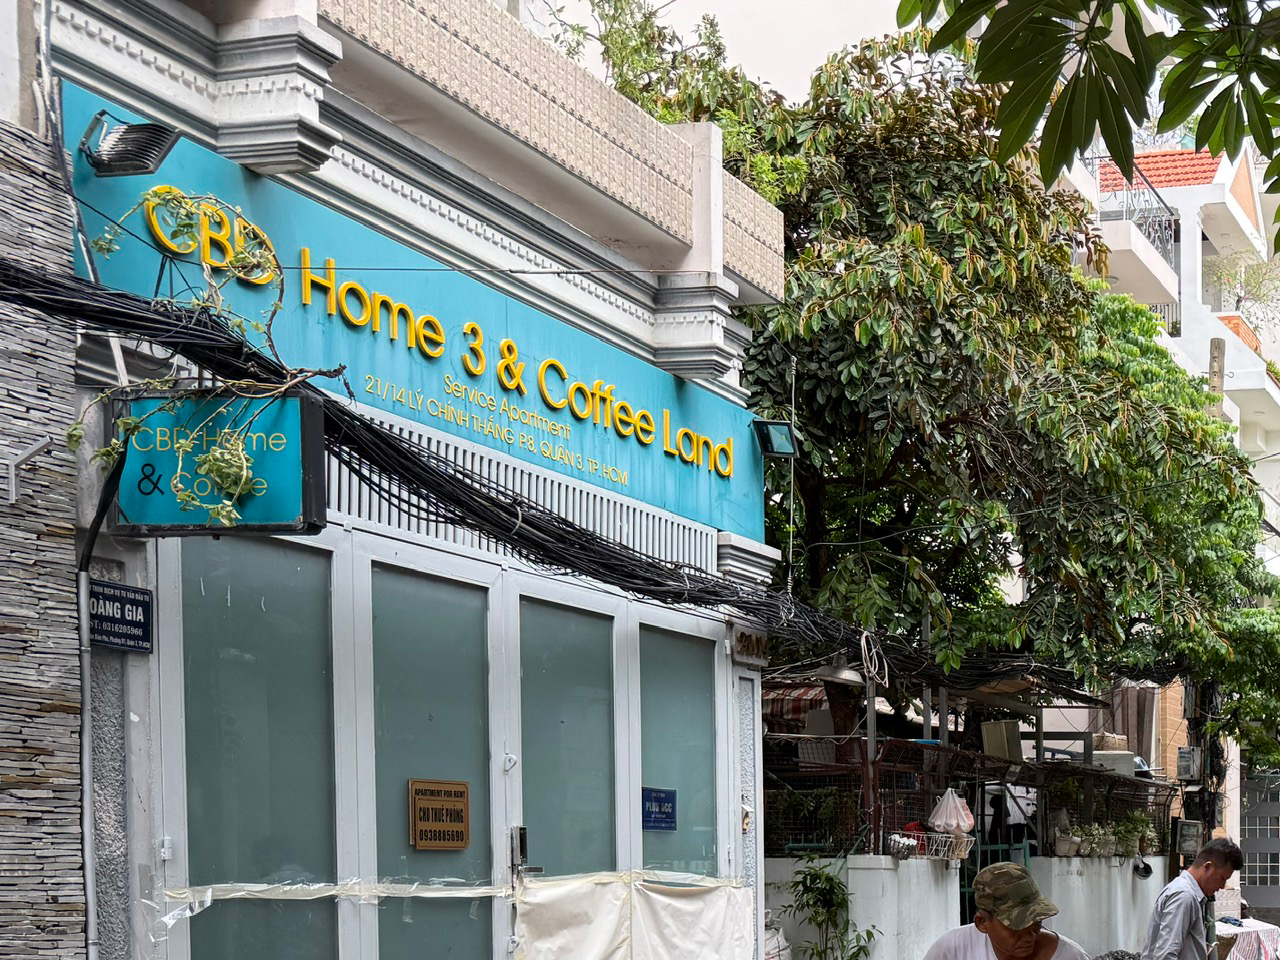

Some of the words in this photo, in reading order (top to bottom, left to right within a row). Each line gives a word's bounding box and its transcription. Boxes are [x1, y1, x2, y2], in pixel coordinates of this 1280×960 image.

[144, 184, 275, 285] CBD
[301, 247, 446, 358] Home
[462, 321, 487, 376] 3
[496, 338, 528, 396] &
[538, 358, 656, 445] Coffee
[663, 408, 734, 478] Land
[365, 374, 406, 406] 21/14
[408, 388, 424, 412] LÝ
[427, 398, 469, 429] CHÍNH
[471, 415, 515, 444] THẮNG
[444, 374, 497, 411] Service
[500, 397, 571, 440] Apartment
[137, 463, 165, 496] &
[170, 471, 268, 497] Coe
[89, 595, 121, 619] OÀNG
[125, 604, 145, 623] GIA
[414, 788, 443, 798] APARTMENT
[443, 790, 453, 798] FOR
[453, 790, 466, 798] RENT
[418, 806, 430, 823] CHO
